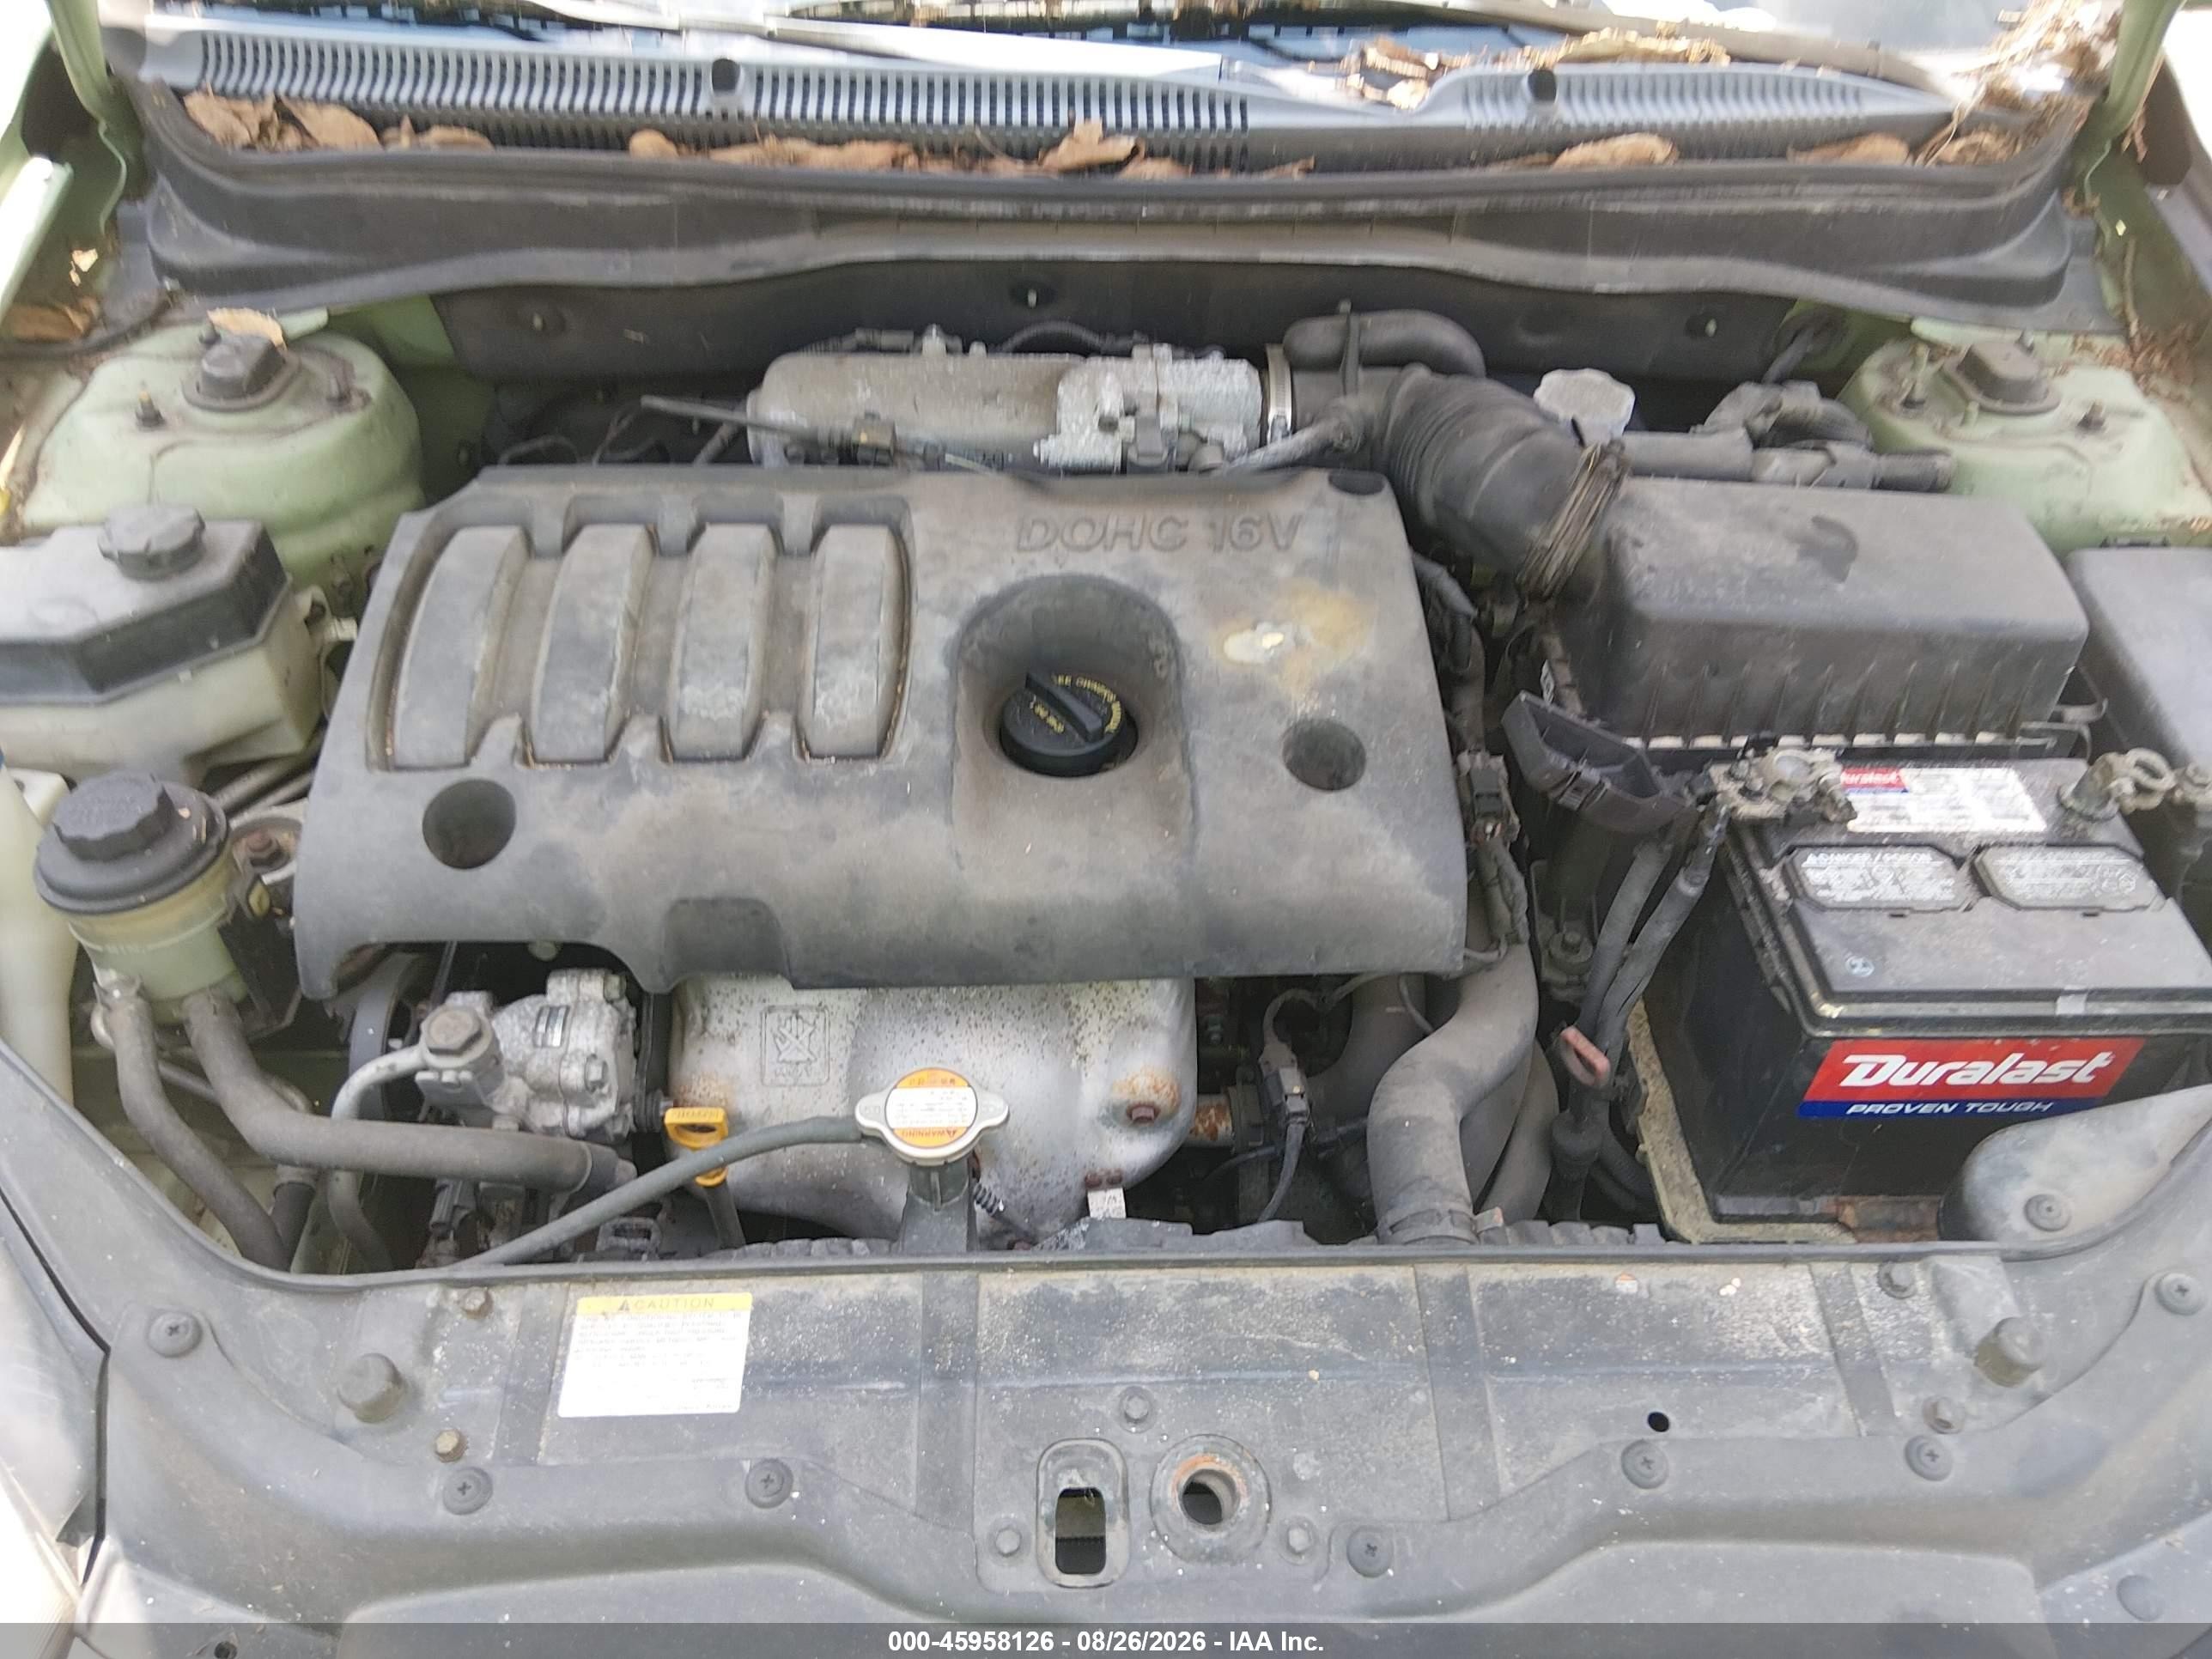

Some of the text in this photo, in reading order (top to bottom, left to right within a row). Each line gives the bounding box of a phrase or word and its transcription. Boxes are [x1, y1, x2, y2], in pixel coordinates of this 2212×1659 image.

[1016, 513, 1303, 553] DOHC 16V
[1841, 771, 1899, 785] uralast
[1839, 1051, 2115, 1087] Duralast
[1846, 1101, 2053, 1115] PROVEN TOUGH
[634, 1297, 715, 1309] CAUTION
